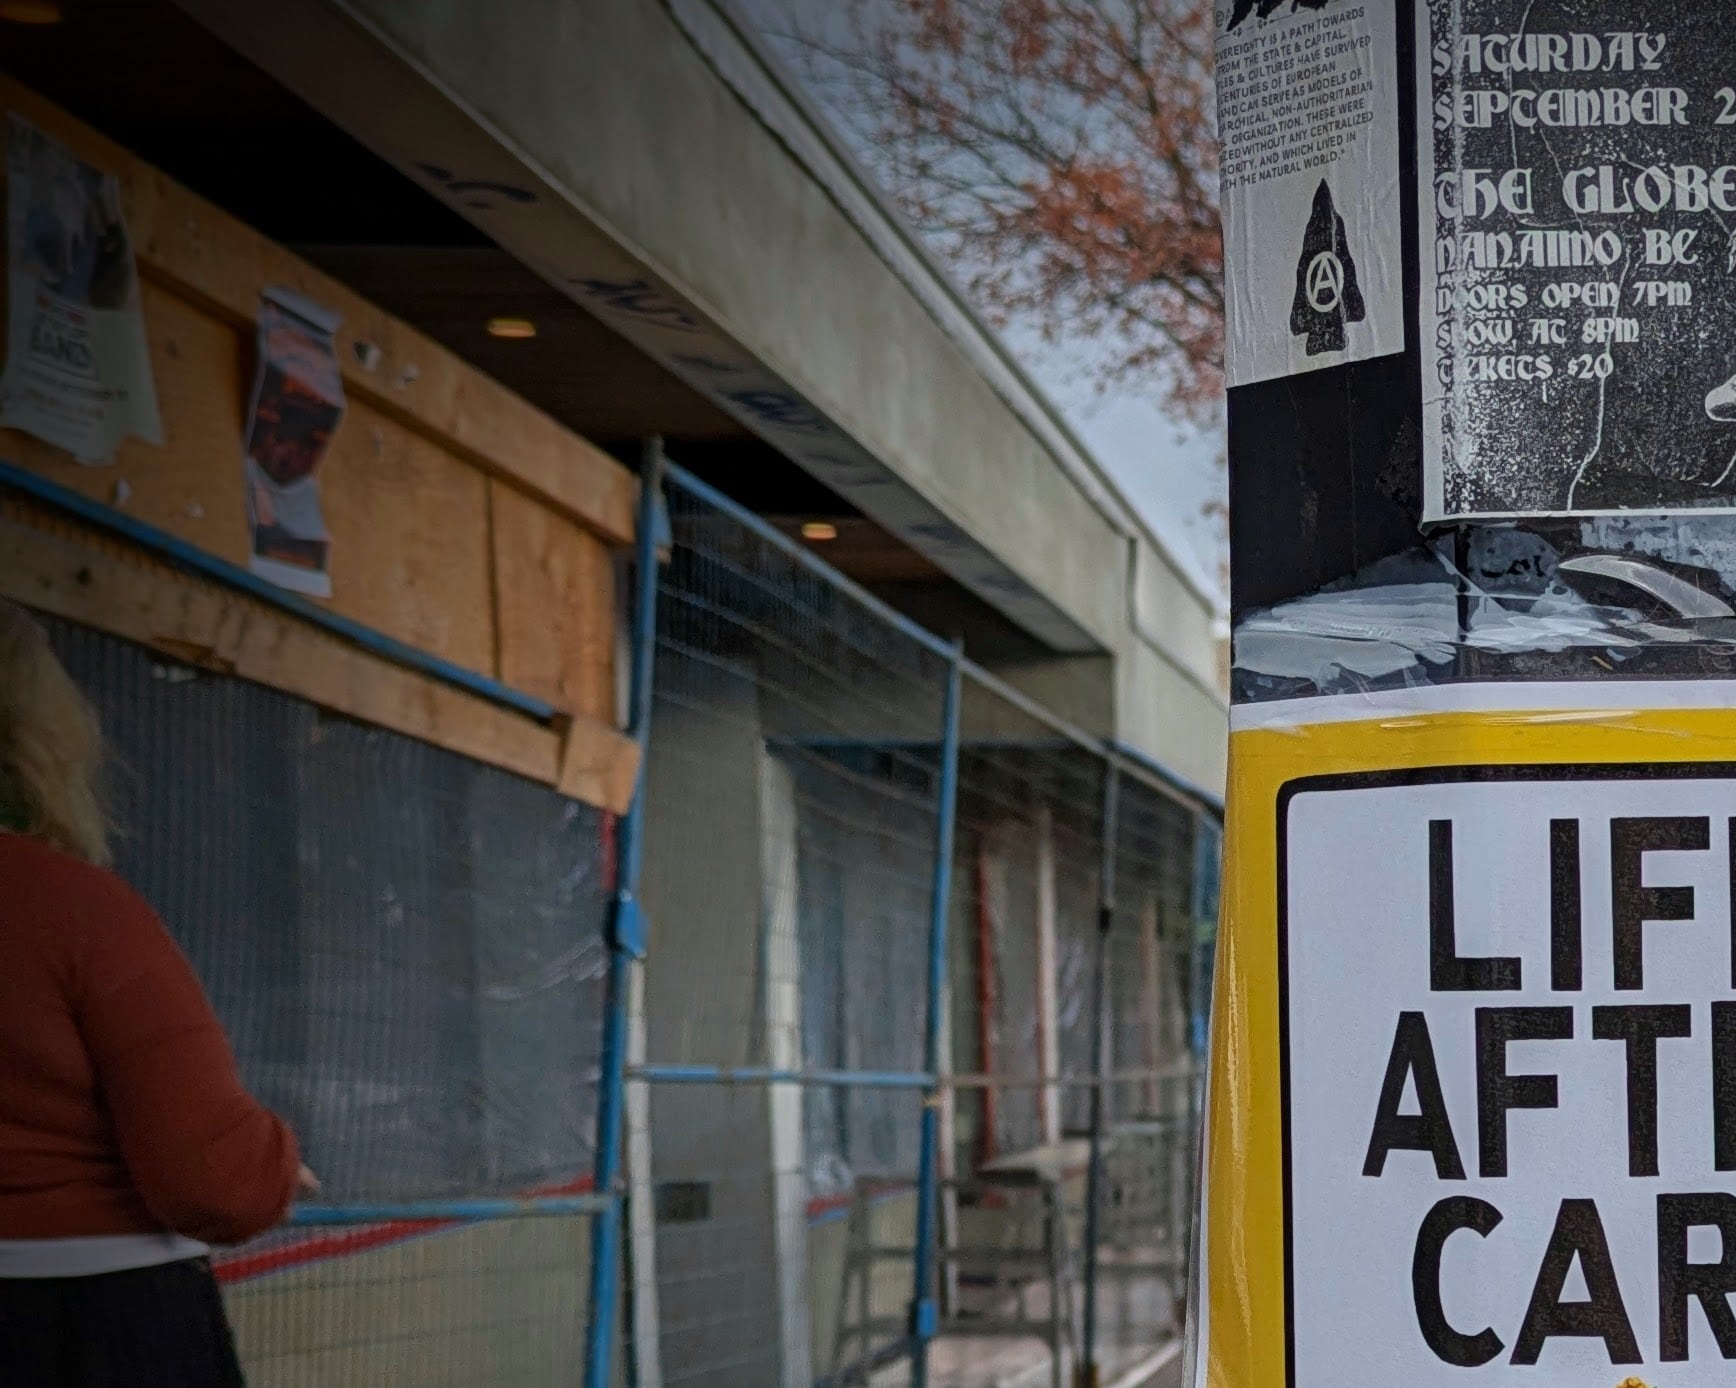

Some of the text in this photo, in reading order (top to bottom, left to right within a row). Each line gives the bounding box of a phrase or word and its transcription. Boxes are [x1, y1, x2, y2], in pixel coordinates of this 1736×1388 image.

[1290, 22, 1315, 39] PATH
[1317, 6, 1365, 29] TOWARDS
[1237, 73, 1245, 83] &
[1248, 58, 1295, 81] CULTURES
[1297, 49, 1321, 65] HAVE
[1324, 35, 1371, 58] SURVIVED
[1244, 52, 1259, 68] THE
[1263, 44, 1292, 62] STATE
[1294, 42, 1301, 52] &
[1432, 31, 1667, 77] SATURDAY
[1240, 98, 1259, 112] CAN
[1262, 89, 1291, 107] SERVE
[1293, 85, 1305, 98] AS
[1308, 72, 1347, 93] MODELS
[1350, 67, 1361, 81] OF
[1271, 76, 1282, 89] OF
[1286, 61, 1336, 85] EUROPEAN
[1272, 80, 1373, 118] NON-AUTHORITARIAN
[1306, 106, 1336, 124] THESE
[1339, 97, 1365, 114] WERE
[1432, 87, 1691, 134] SEPTEMBER
[1242, 135, 1286, 156] WITHOUT
[1289, 128, 1308, 143] ANY
[1311, 111, 1374, 138] CENTRALIZED
[1260, 152, 1279, 166] AND
[1282, 143, 1314, 160] WHICH
[1316, 135, 1343, 151] LIVED
[1346, 131, 1356, 143] IN
[1239, 173, 1257, 186] THE
[1259, 162, 1301, 181] NATURAL
[1436, 228, 1699, 273] NANAIMO BC
[1542, 281, 1621, 308] OPEN
[1632, 280, 1692, 307] 7PM
[1529, 318, 1567, 345] AT
[1581, 317, 1640, 344] 8PM
[1567, 352, 1615, 380] $20
